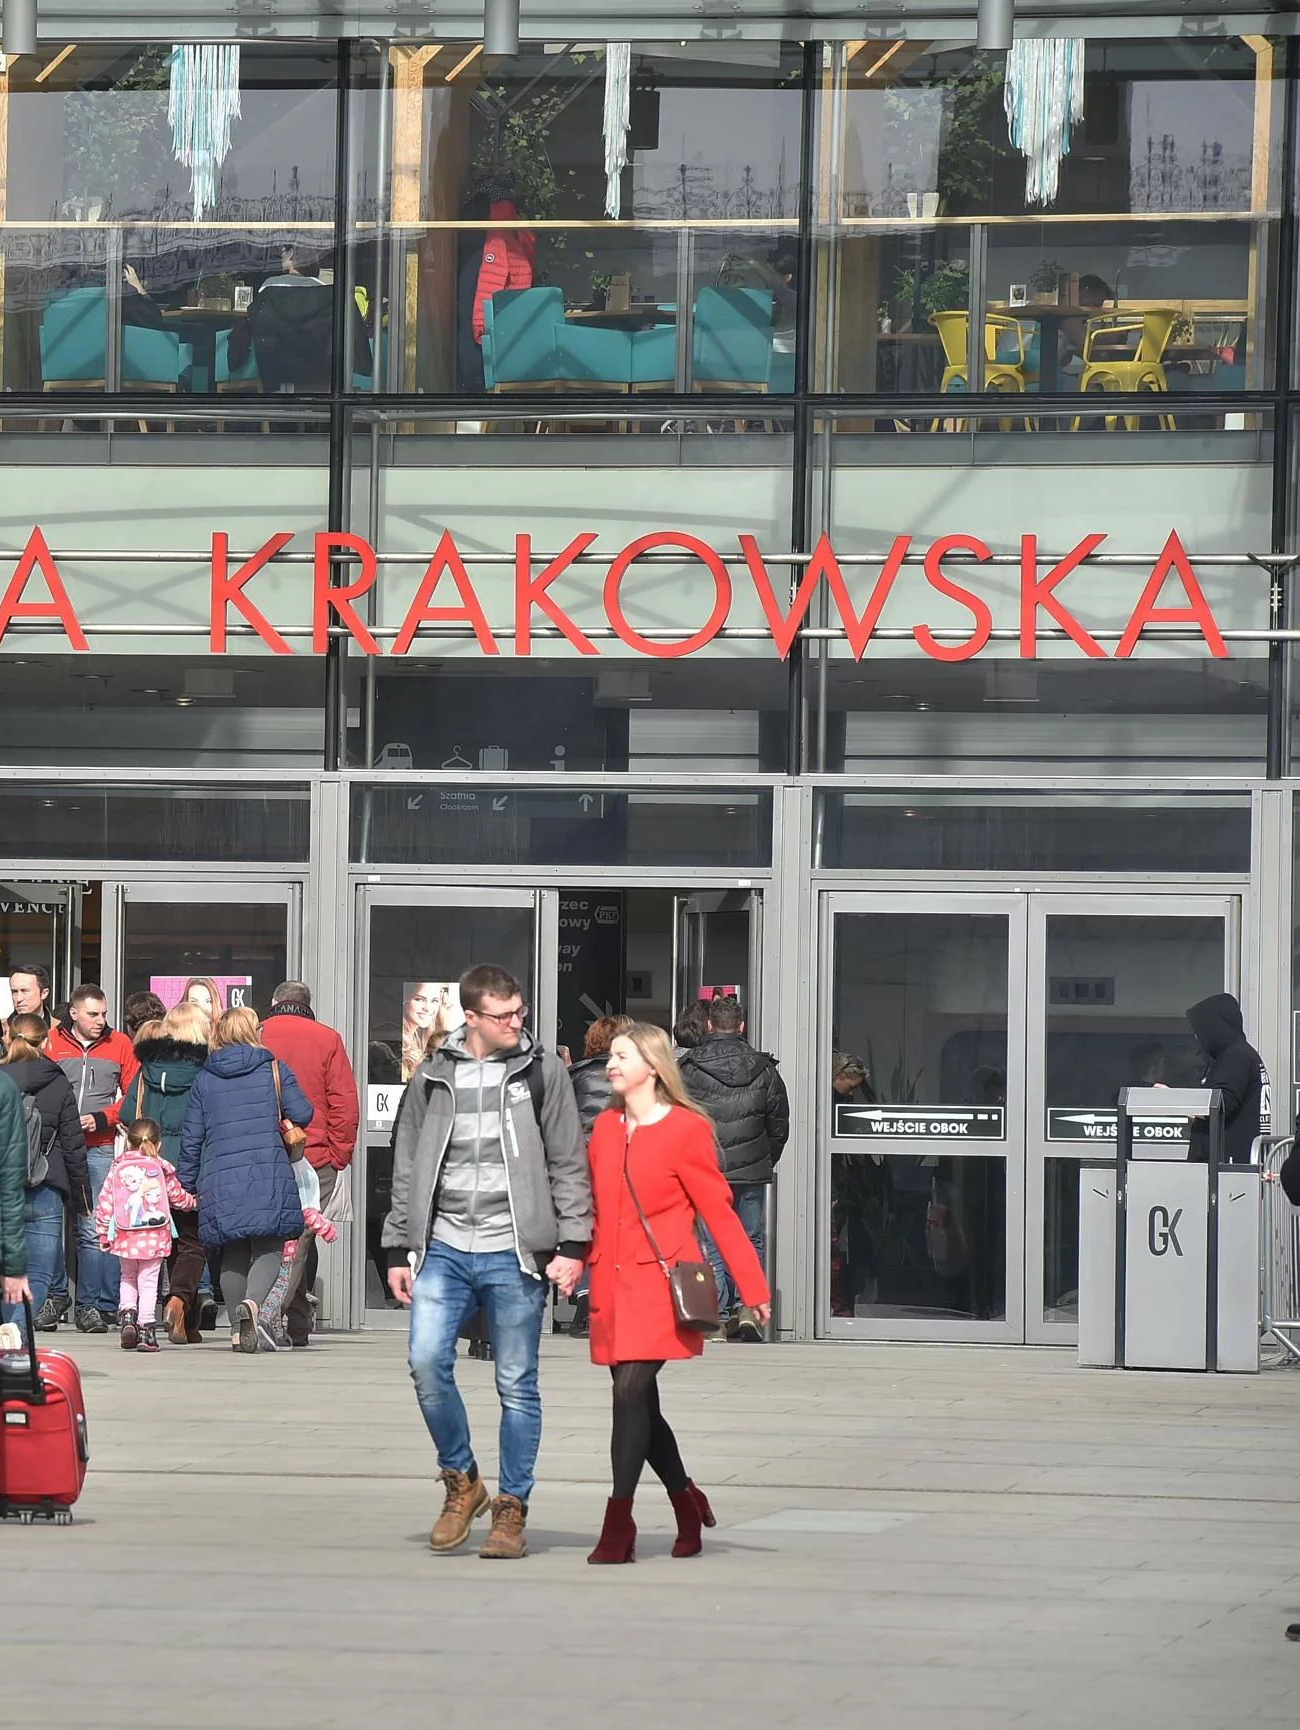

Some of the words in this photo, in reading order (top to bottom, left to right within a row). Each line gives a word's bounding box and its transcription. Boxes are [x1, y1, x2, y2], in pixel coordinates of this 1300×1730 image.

[209, 527, 1230, 663] KRAKOWSKA
[440, 791, 476, 801] Szatnia
[440, 803, 479, 811] Cloakroom
[598, 910, 618, 920] PKP
[871, 1120, 926, 1133] WEJŚCIE
[930, 1123, 968, 1134] OBOK
[1083, 1124, 1140, 1137] WEJŚE
[1144, 1126, 1183, 1138] OBOK
[1148, 1205, 1184, 1257] GK
